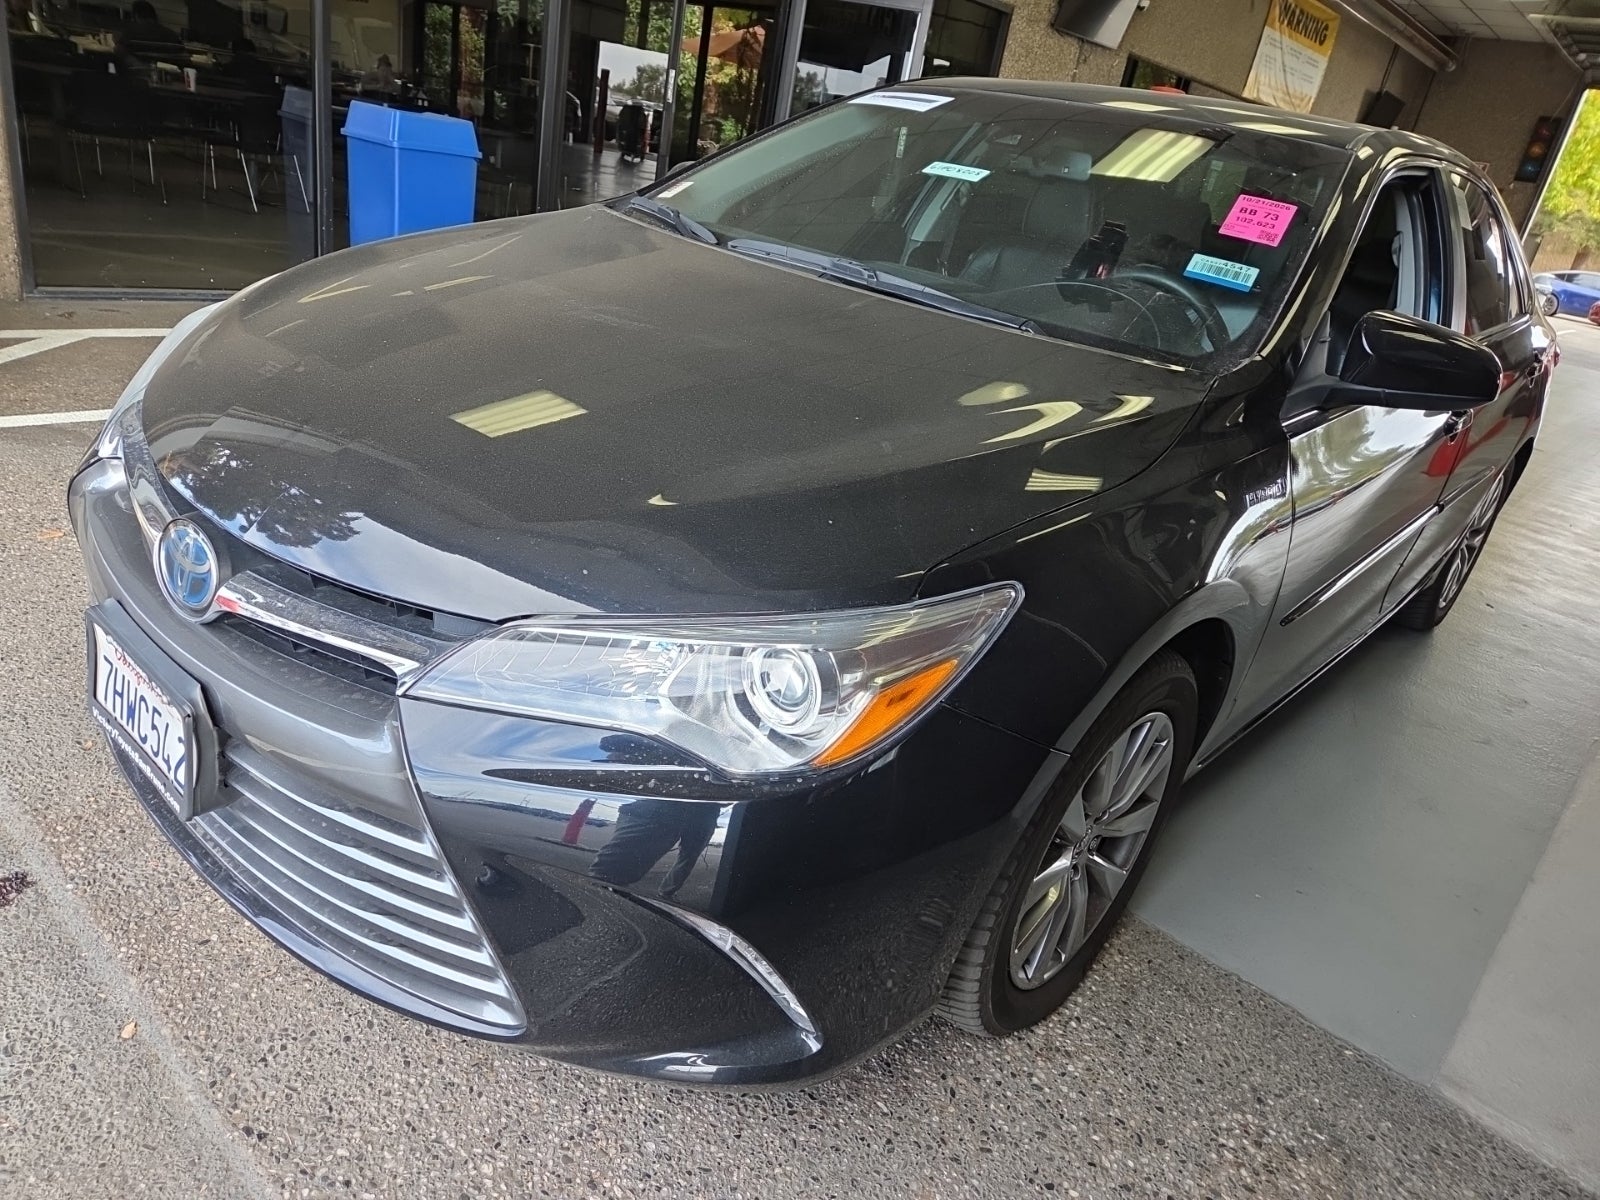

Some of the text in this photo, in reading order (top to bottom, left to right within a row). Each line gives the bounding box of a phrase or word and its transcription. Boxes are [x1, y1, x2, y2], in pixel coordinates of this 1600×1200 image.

[1279, 0, 1329, 46] WARNING
[1239, 207, 1258, 216] BB
[1263, 211, 1280, 221] 73
